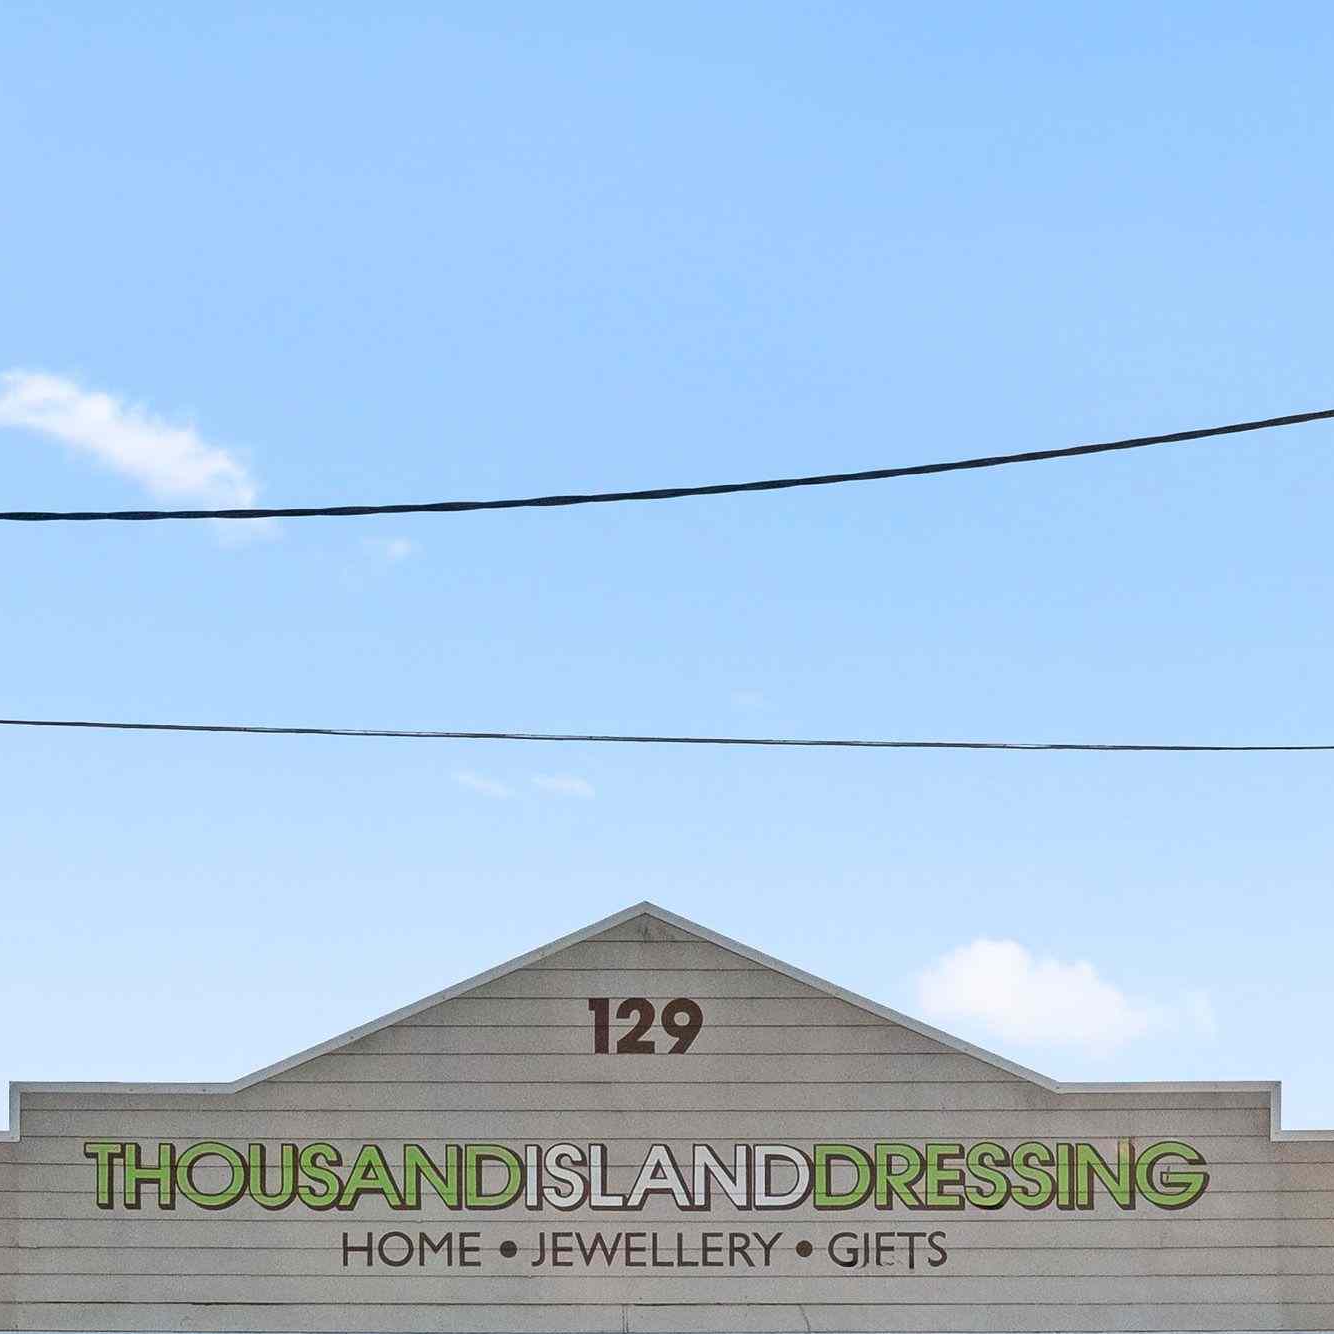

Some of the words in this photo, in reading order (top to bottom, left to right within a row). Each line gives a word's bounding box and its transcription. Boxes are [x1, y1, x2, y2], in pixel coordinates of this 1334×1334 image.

[588, 997, 704, 1054] 129
[342, 1231, 481, 1267] HOME
[532, 1231, 783, 1268] JEWELLERY
